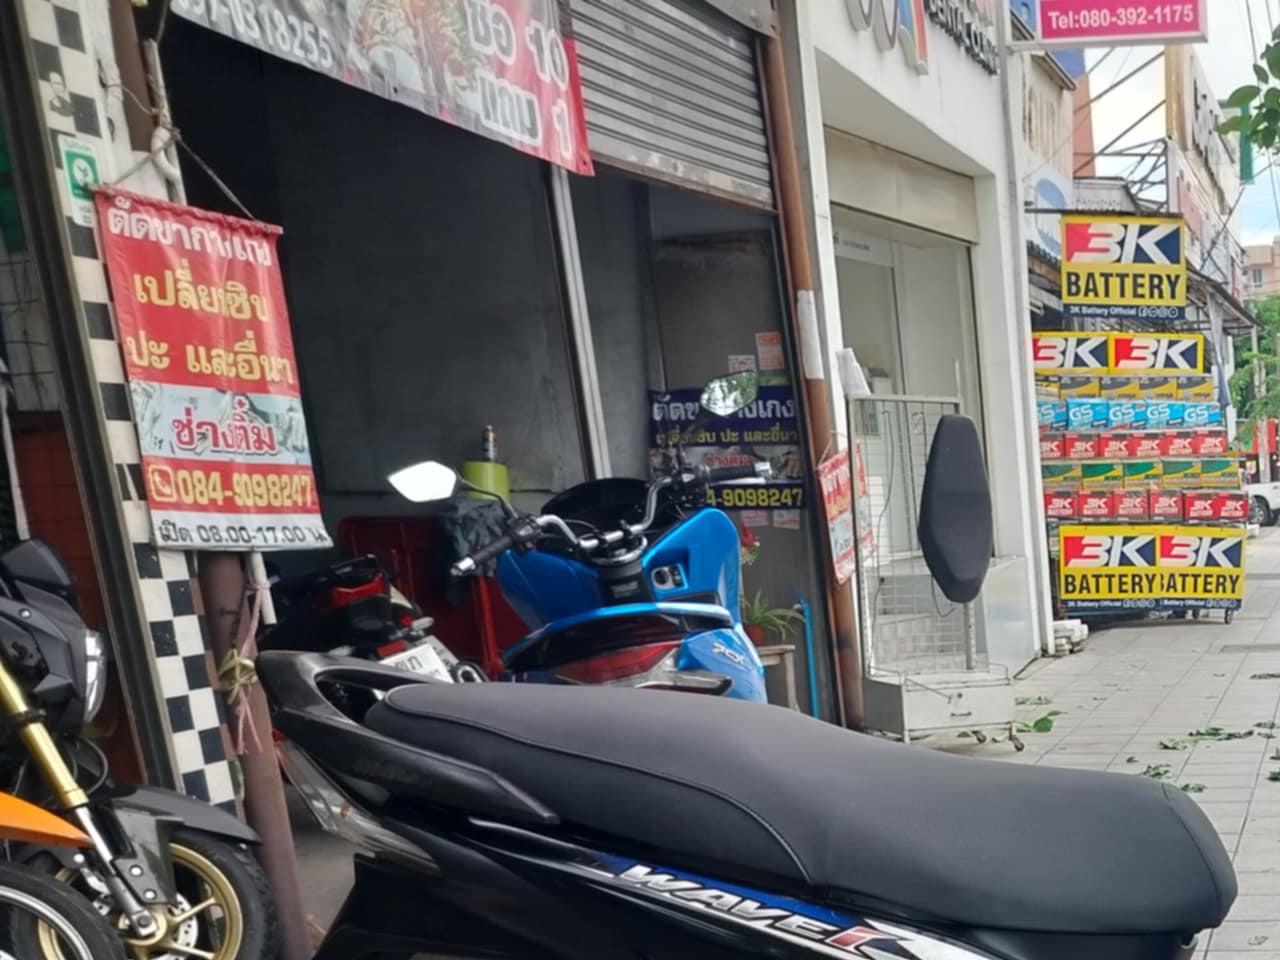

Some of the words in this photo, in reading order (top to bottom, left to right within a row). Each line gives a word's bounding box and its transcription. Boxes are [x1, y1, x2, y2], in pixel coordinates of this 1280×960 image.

[1048, 4, 1195, 29] Tel:080-392-1175
[1070, 223, 1181, 265] 3K
[1066, 271, 1181, 300] BATTERY
[126, 330, 170, 370] ปะ
[1033, 336, 1108, 369] 3K
[1118, 338, 1198, 370] 3K
[1069, 404, 1093, 420] GS
[1109, 404, 1135, 421] GS
[1146, 404, 1171, 419] GS
[1184, 406, 1209, 421] GS
[176, 469, 312, 507] 084-9098247
[706, 488, 803, 507] 4-9098247
[158, 519, 193, 543] เปิด
[196, 525, 306, 543] 08.00-17.00
[1067, 535, 1155, 567] 3K
[1160, 536, 1242, 568] 3K
[1064, 573, 1156, 594] BATTERY
